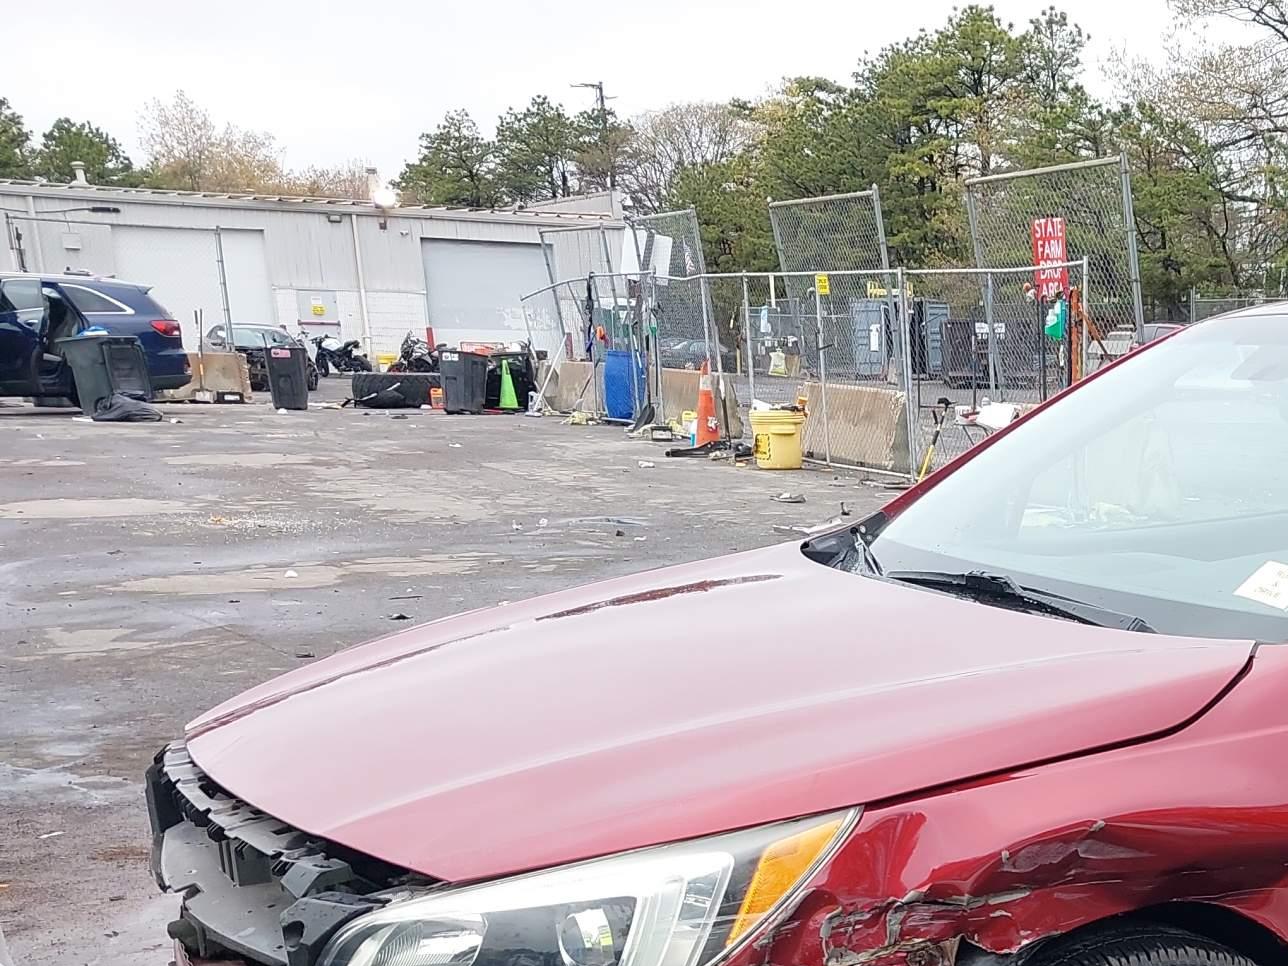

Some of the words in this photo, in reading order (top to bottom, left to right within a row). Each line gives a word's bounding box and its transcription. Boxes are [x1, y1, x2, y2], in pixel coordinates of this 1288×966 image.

[1034, 217, 1063, 238] STATE
[1037, 239, 1063, 259] FARM
[1040, 260, 1063, 280] DROP
